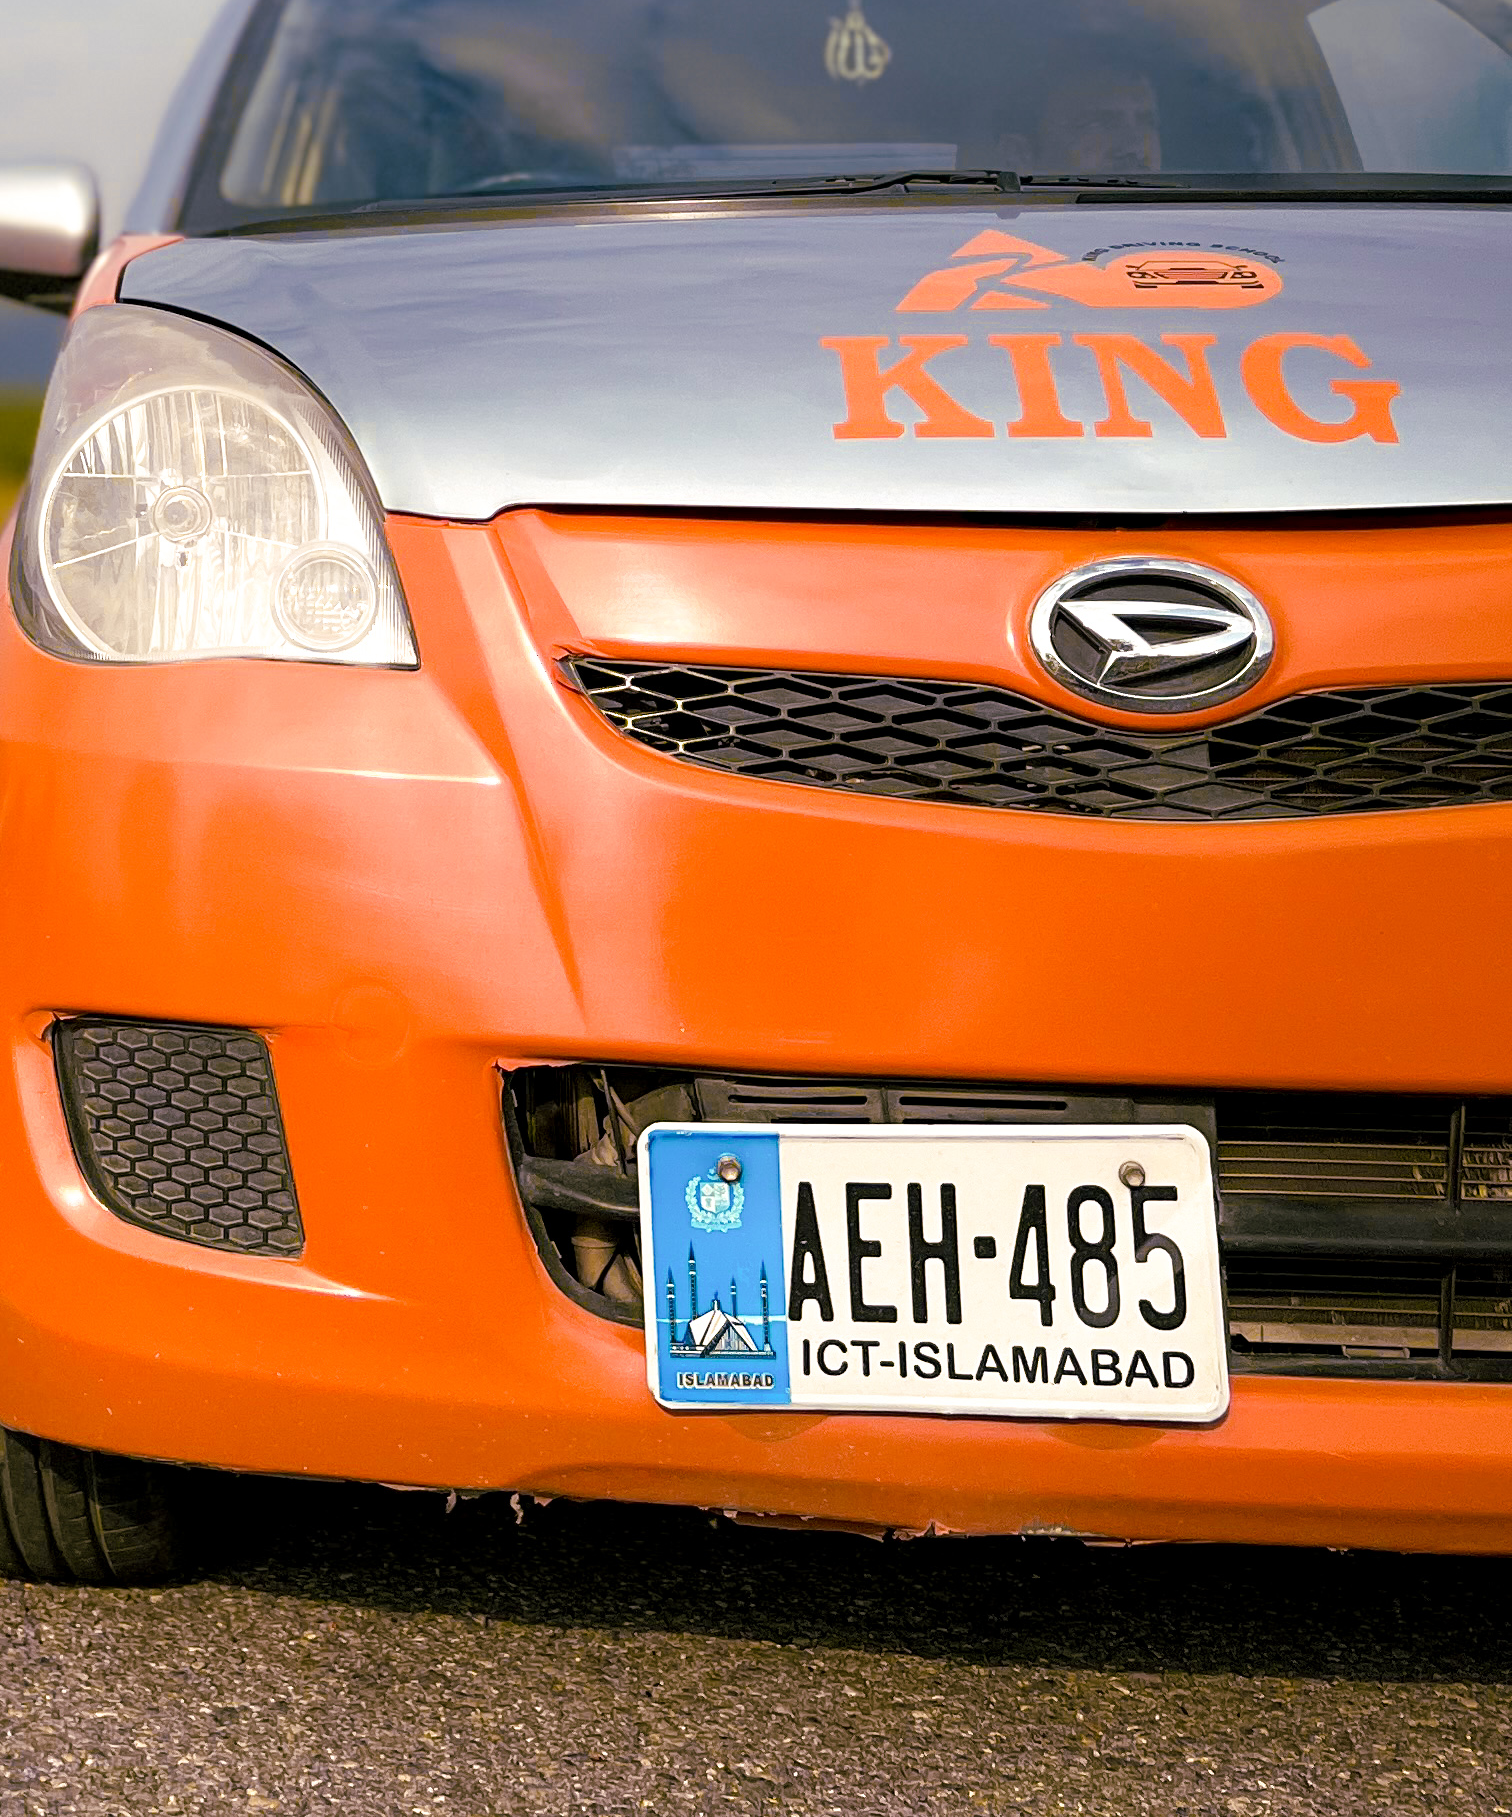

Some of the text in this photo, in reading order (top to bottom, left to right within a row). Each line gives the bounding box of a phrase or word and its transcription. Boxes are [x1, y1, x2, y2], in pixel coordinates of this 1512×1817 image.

[820, 333, 1401, 444] KING
[678, 1372, 775, 1388] ISLAMABAD
[802, 1338, 1195, 1389] ICT-ISLAMABAD
